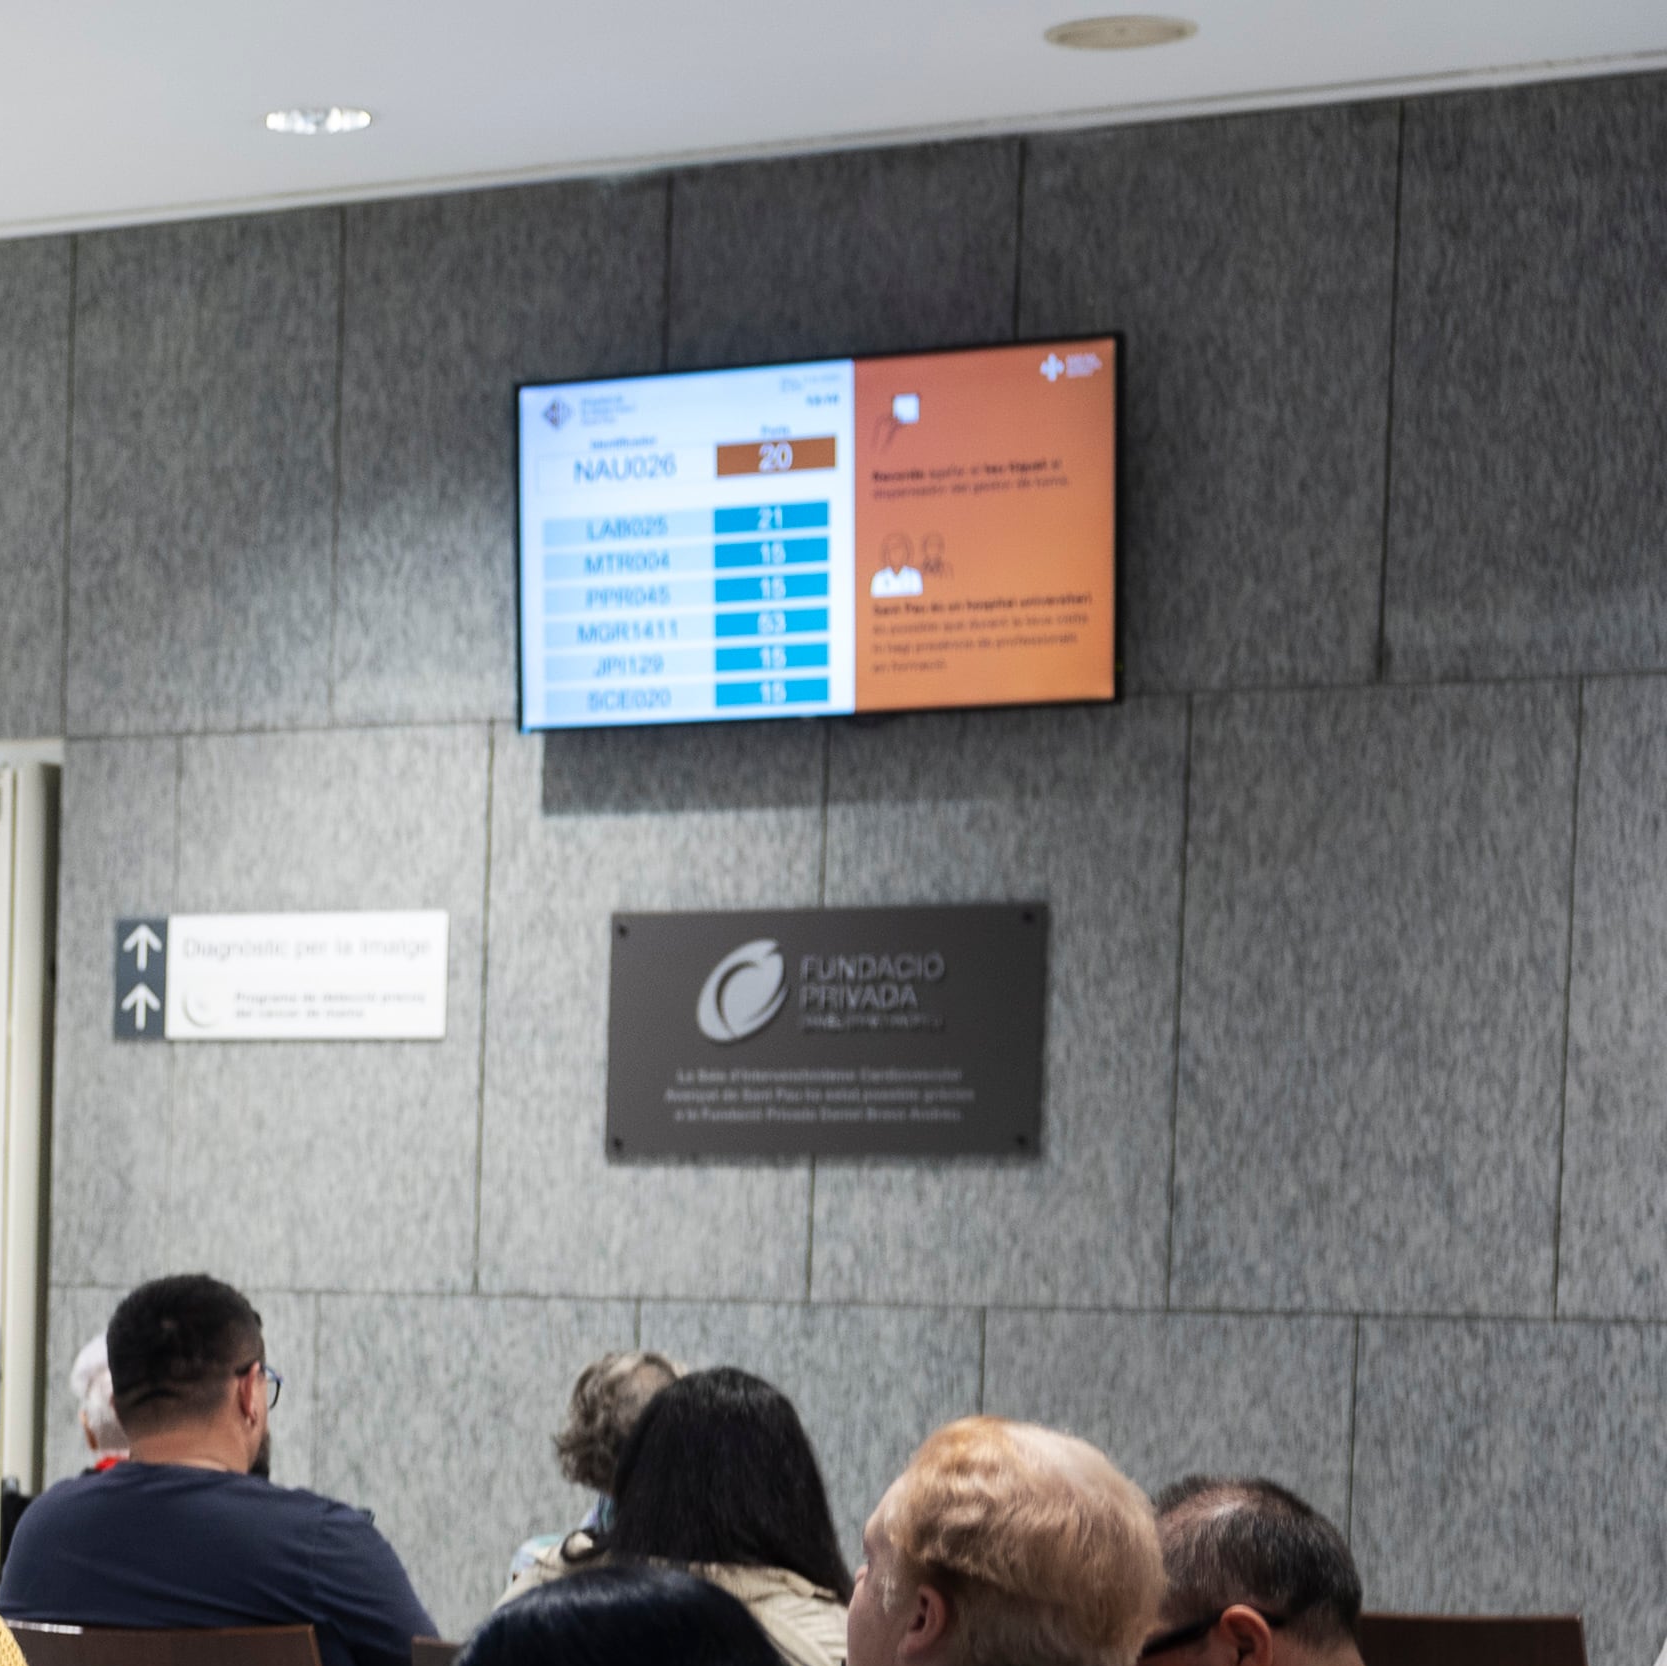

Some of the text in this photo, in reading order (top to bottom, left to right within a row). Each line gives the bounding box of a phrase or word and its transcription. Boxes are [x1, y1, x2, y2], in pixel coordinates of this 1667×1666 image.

[574, 453, 676, 484] NAU026
[759, 441, 793, 472] 20
[799, 982, 919, 1010] PRIVADA
